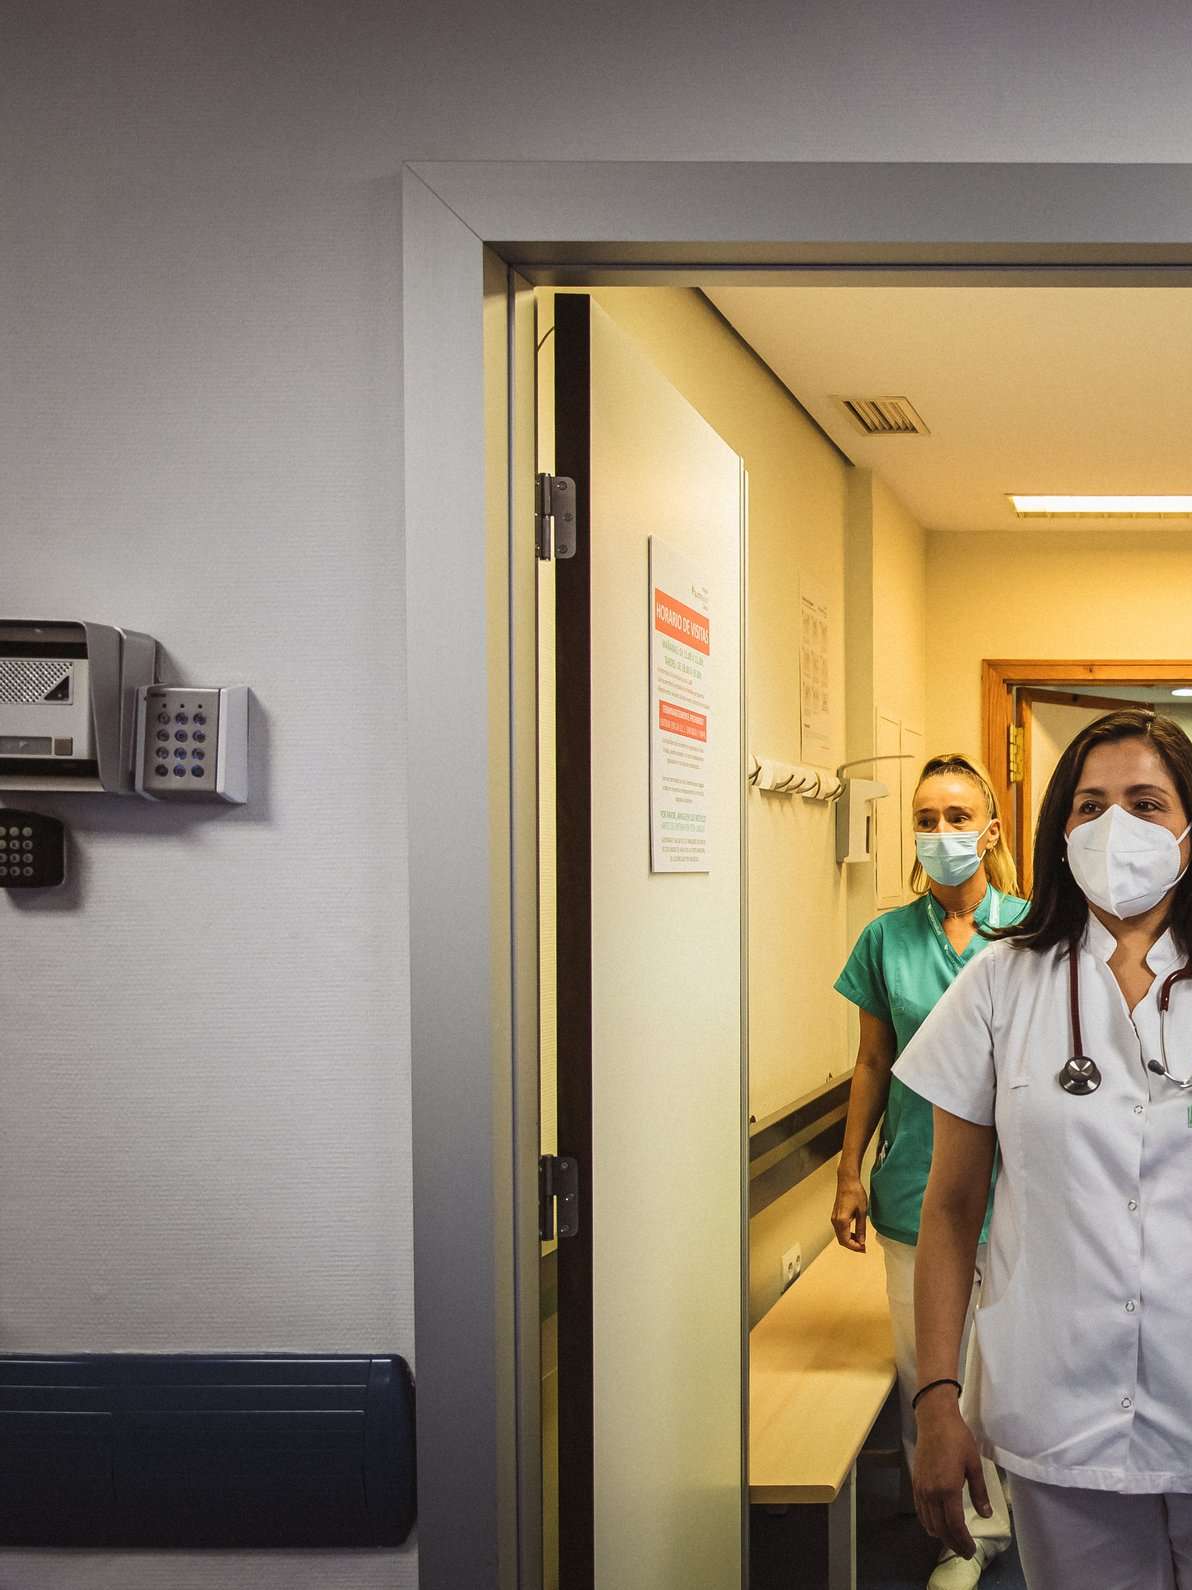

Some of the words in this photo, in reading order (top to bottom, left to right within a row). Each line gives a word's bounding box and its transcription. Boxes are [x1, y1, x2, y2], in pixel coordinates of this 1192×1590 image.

[656, 602, 682, 630] HORARIO
[683, 616, 691, 635] DE
[691, 620, 709, 645] VISITAS
